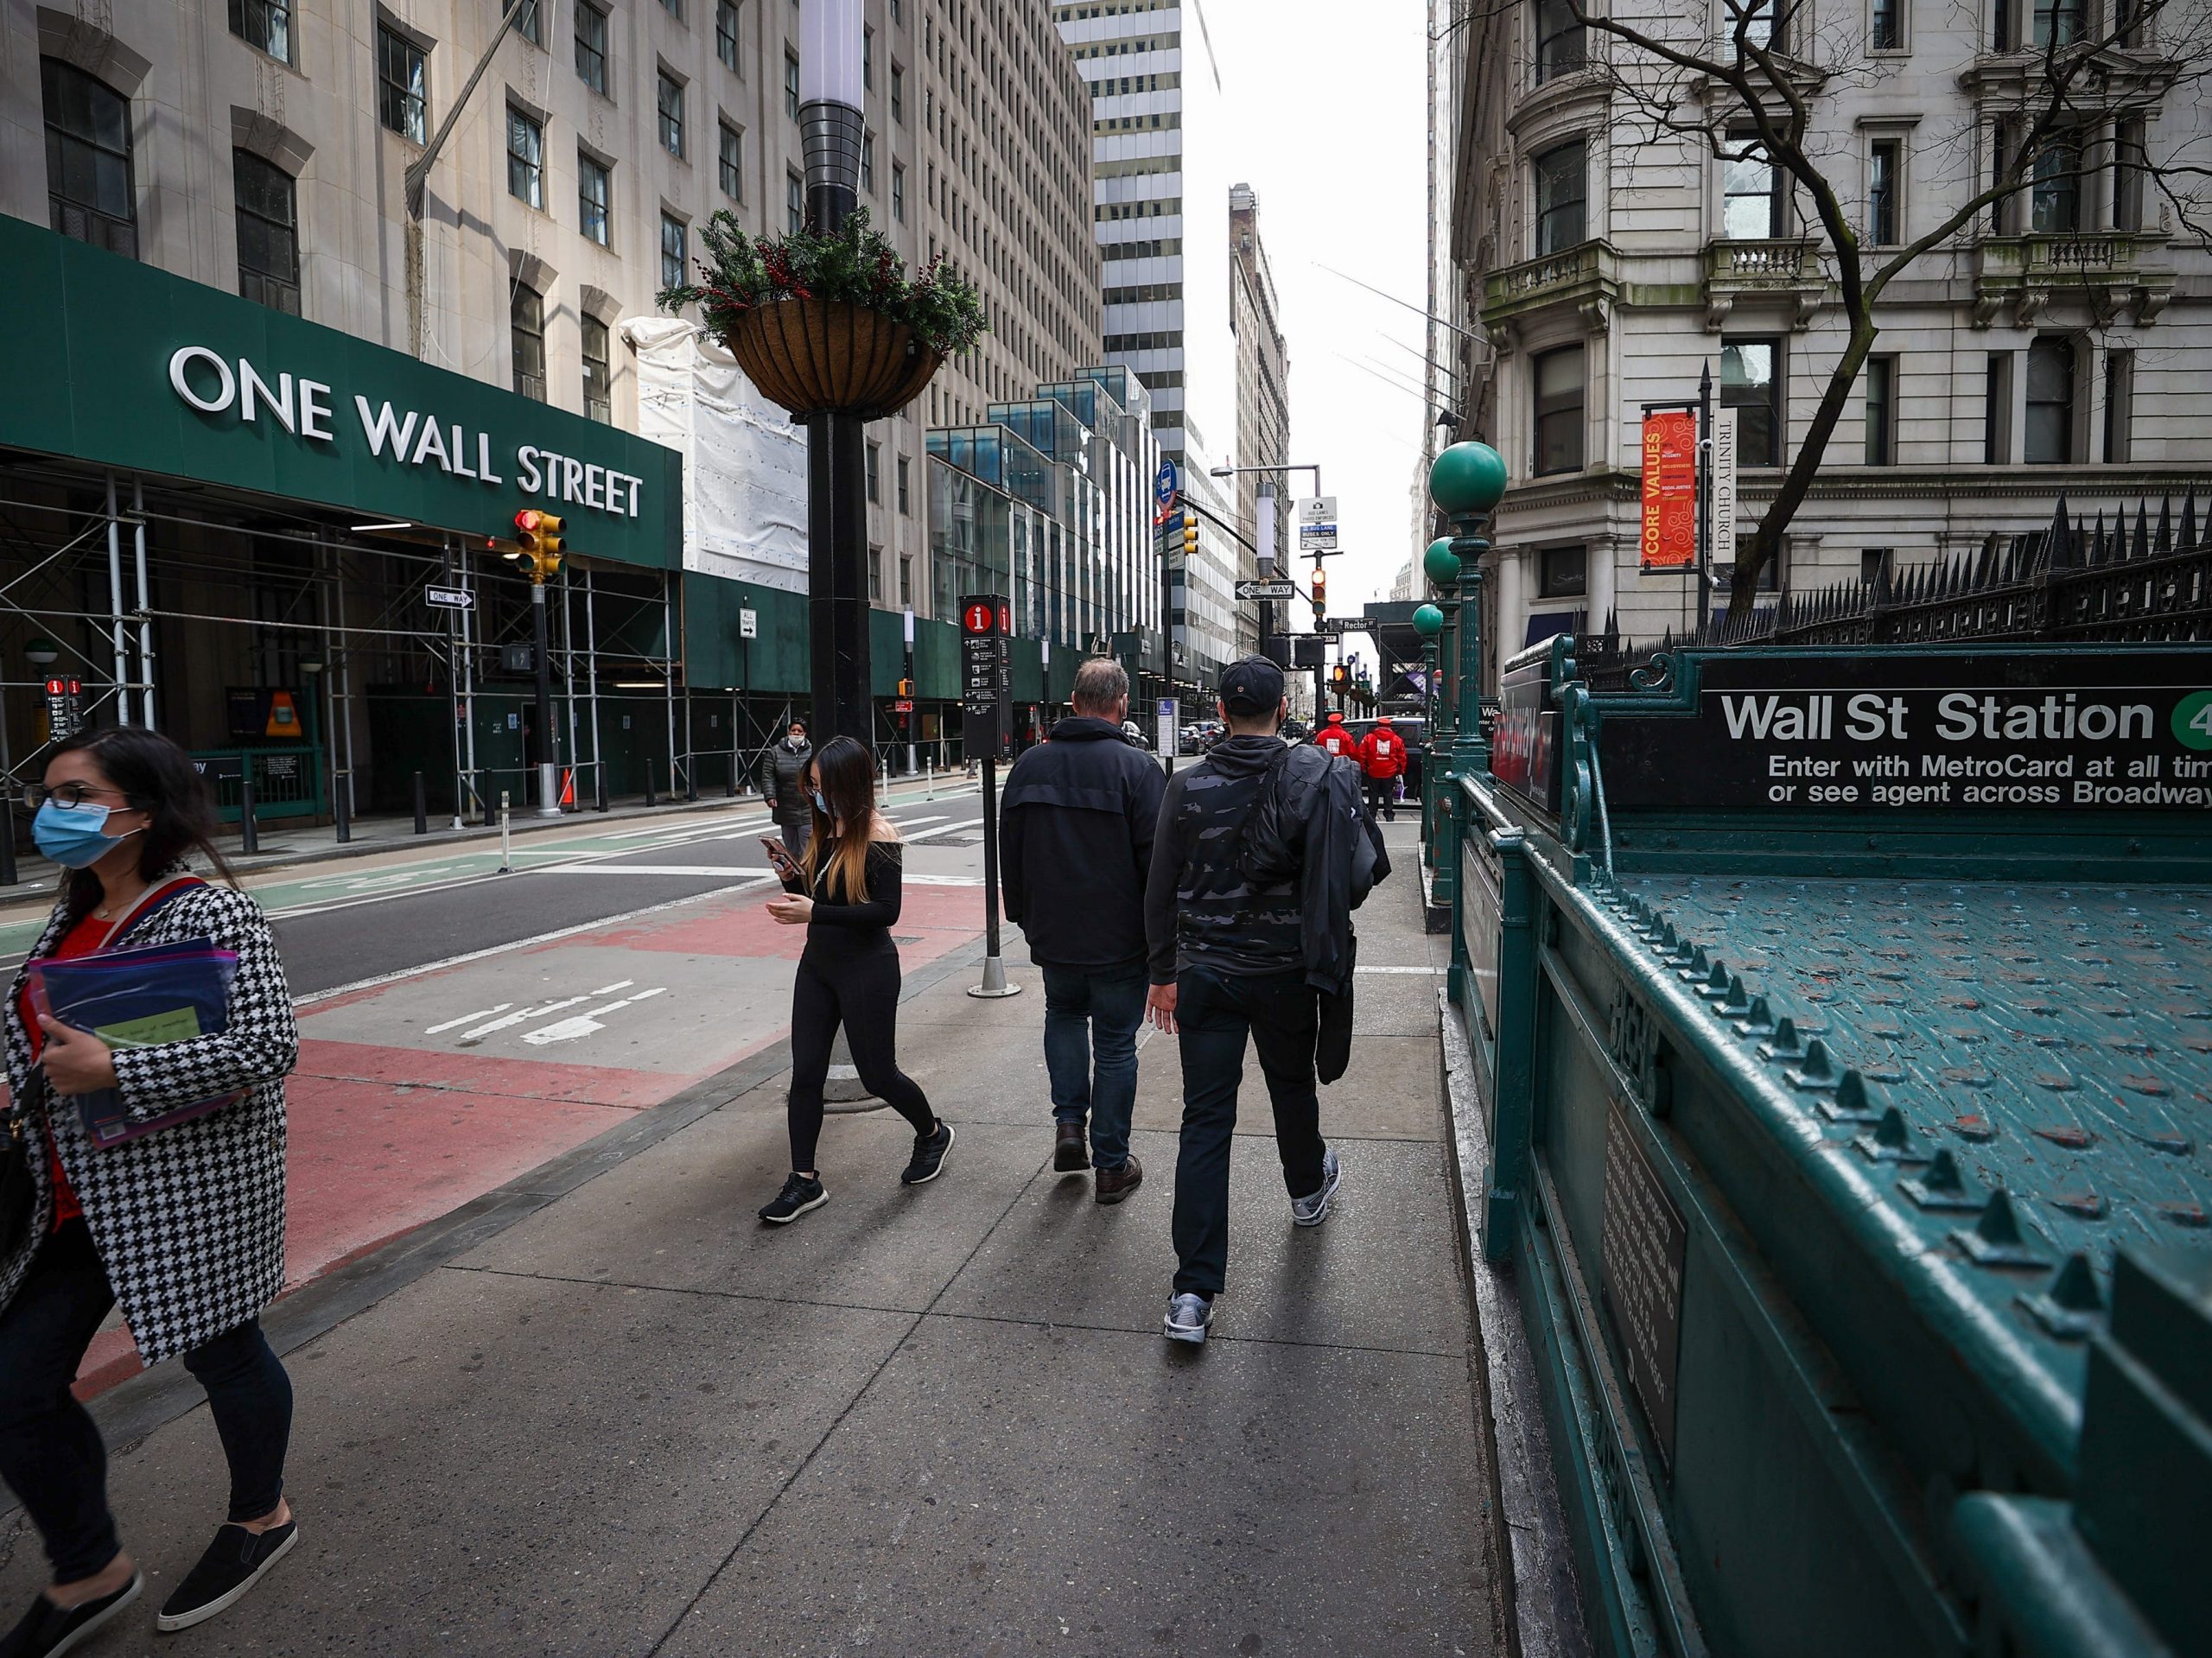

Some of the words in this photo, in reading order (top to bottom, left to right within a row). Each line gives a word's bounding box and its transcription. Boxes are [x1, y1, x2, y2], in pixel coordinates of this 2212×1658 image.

[169, 346, 334, 441] ONE
[354, 395, 502, 484] WALL
[517, 445, 643, 518] STREET
[1719, 421, 1732, 481] TRINITY
[1646, 432, 1660, 499] VALUES
[1645, 505, 1660, 555] CORE
[1718, 486, 1732, 550] CHURCH
[433, 592, 448, 601] ONE
[454, 594, 467, 603] WAY
[1243, 586, 1261, 594] ONE
[1270, 586, 1290, 594] WAY
[1482, 708, 1500, 716] Wa
[1501, 692, 1536, 776] Subway
[1721, 696, 1833, 740] Wall
[1845, 693, 1909, 740] St
[1936, 693, 2153, 740] Station
[2190, 703, 2212, 736] 4
[1768, 785, 1796, 802] or
[1808, 785, 1859, 803] see
[1872, 781, 1950, 806] agent
[1963, 785, 2060, 804] across
[2074, 781, 2212, 809] Broadway
[1769, 755, 1840, 777] Enter
[1853, 755, 1910, 777] with
[1922, 754, 2073, 778] MetroCard
[2085, 756, 2114, 778] at
[2127, 755, 2159, 778] all
[1626, 1174, 1631, 1197] to
[1632, 1186, 1646, 1227] these
[1647, 1221, 1666, 1268] railings
[1668, 1262, 1679, 1293] will
[1632, 1160, 1645, 1192] other
[1646, 1186, 1671, 1243] property
[1612, 1178, 1630, 1225] removed
[1631, 1219, 1641, 1248] and
[1642, 1241, 1666, 1303] delivered
[1667, 1293, 1675, 1321] to
[1612, 1203, 1622, 1236] Lost
[1622, 1225, 1643, 1285] Property
[1643, 1272, 1654, 1312] Unit
[1624, 1262, 1631, 1288] 34
[1650, 1324, 1658, 1352] Av
[1624, 1288, 1665, 1403] 712-4500/4501
